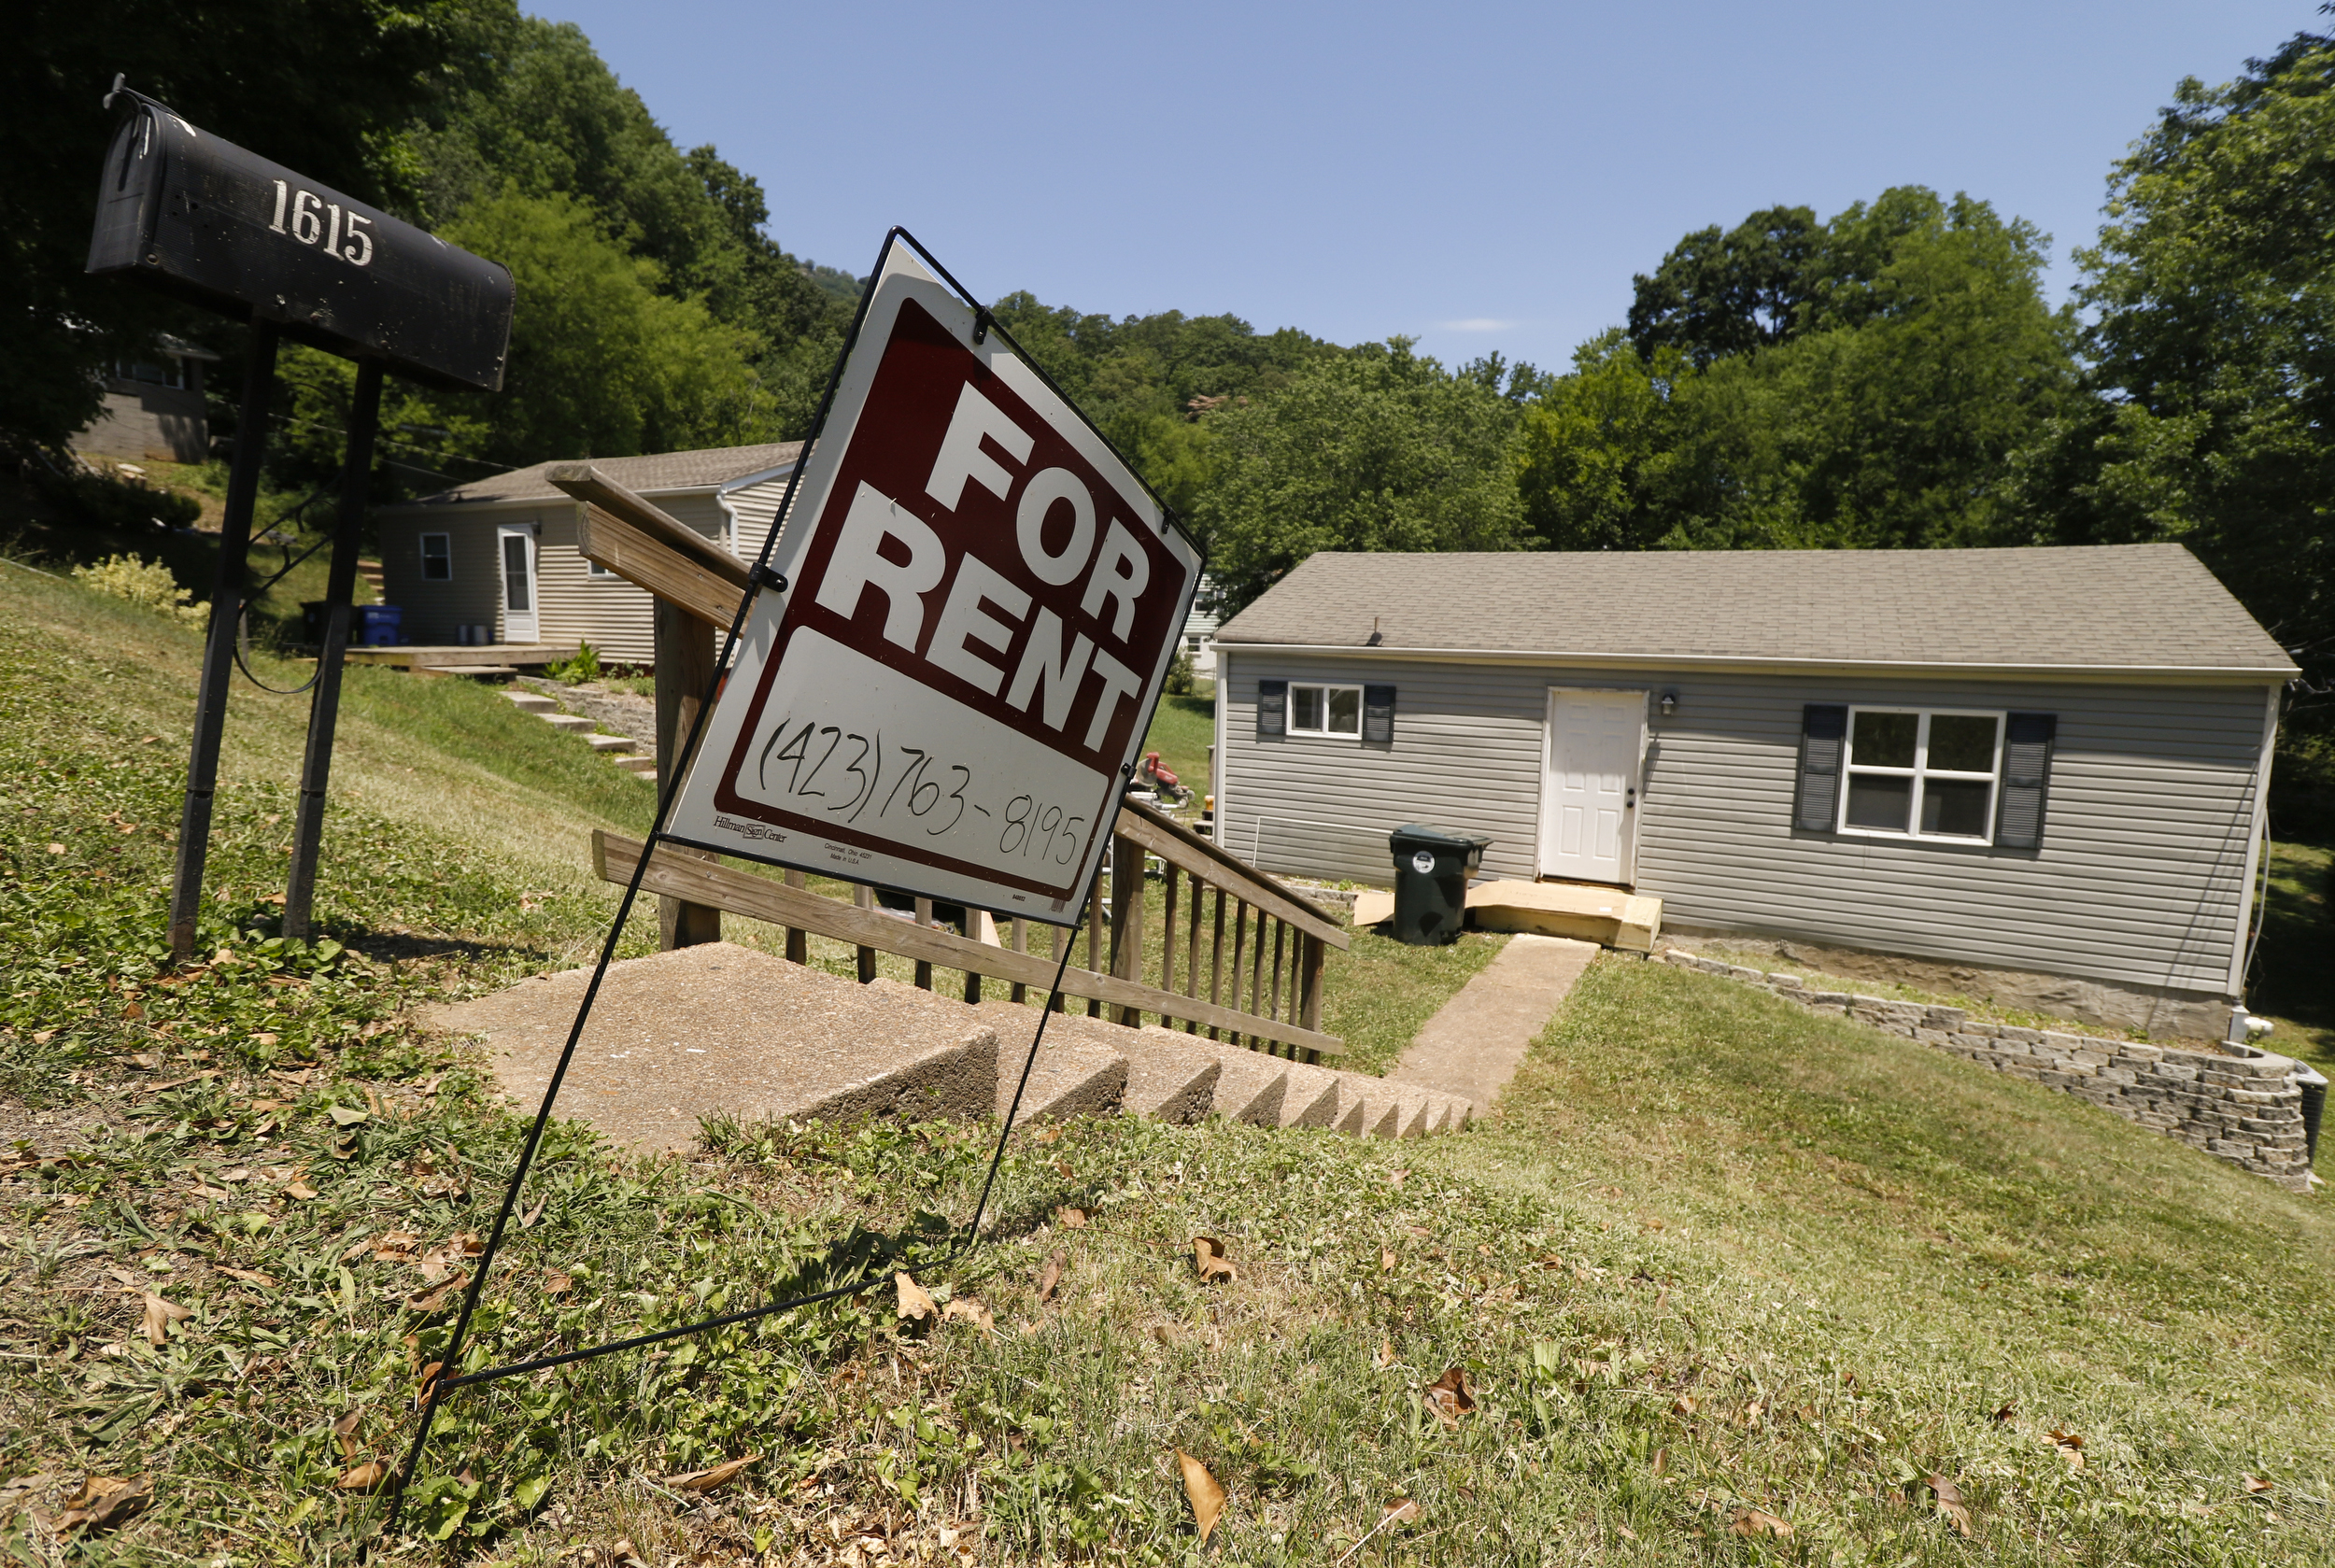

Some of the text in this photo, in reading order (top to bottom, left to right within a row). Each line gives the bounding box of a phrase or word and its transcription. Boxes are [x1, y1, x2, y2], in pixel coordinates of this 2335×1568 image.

[269, 179, 374, 266] 1615
[924, 379, 1150, 644] FOR
[814, 479, 1142, 753] RENT
[713, 815, 787, 843] Hillman Sign Center
[829, 853, 842, 861] Made
[847, 848, 858, 856] Ohio
